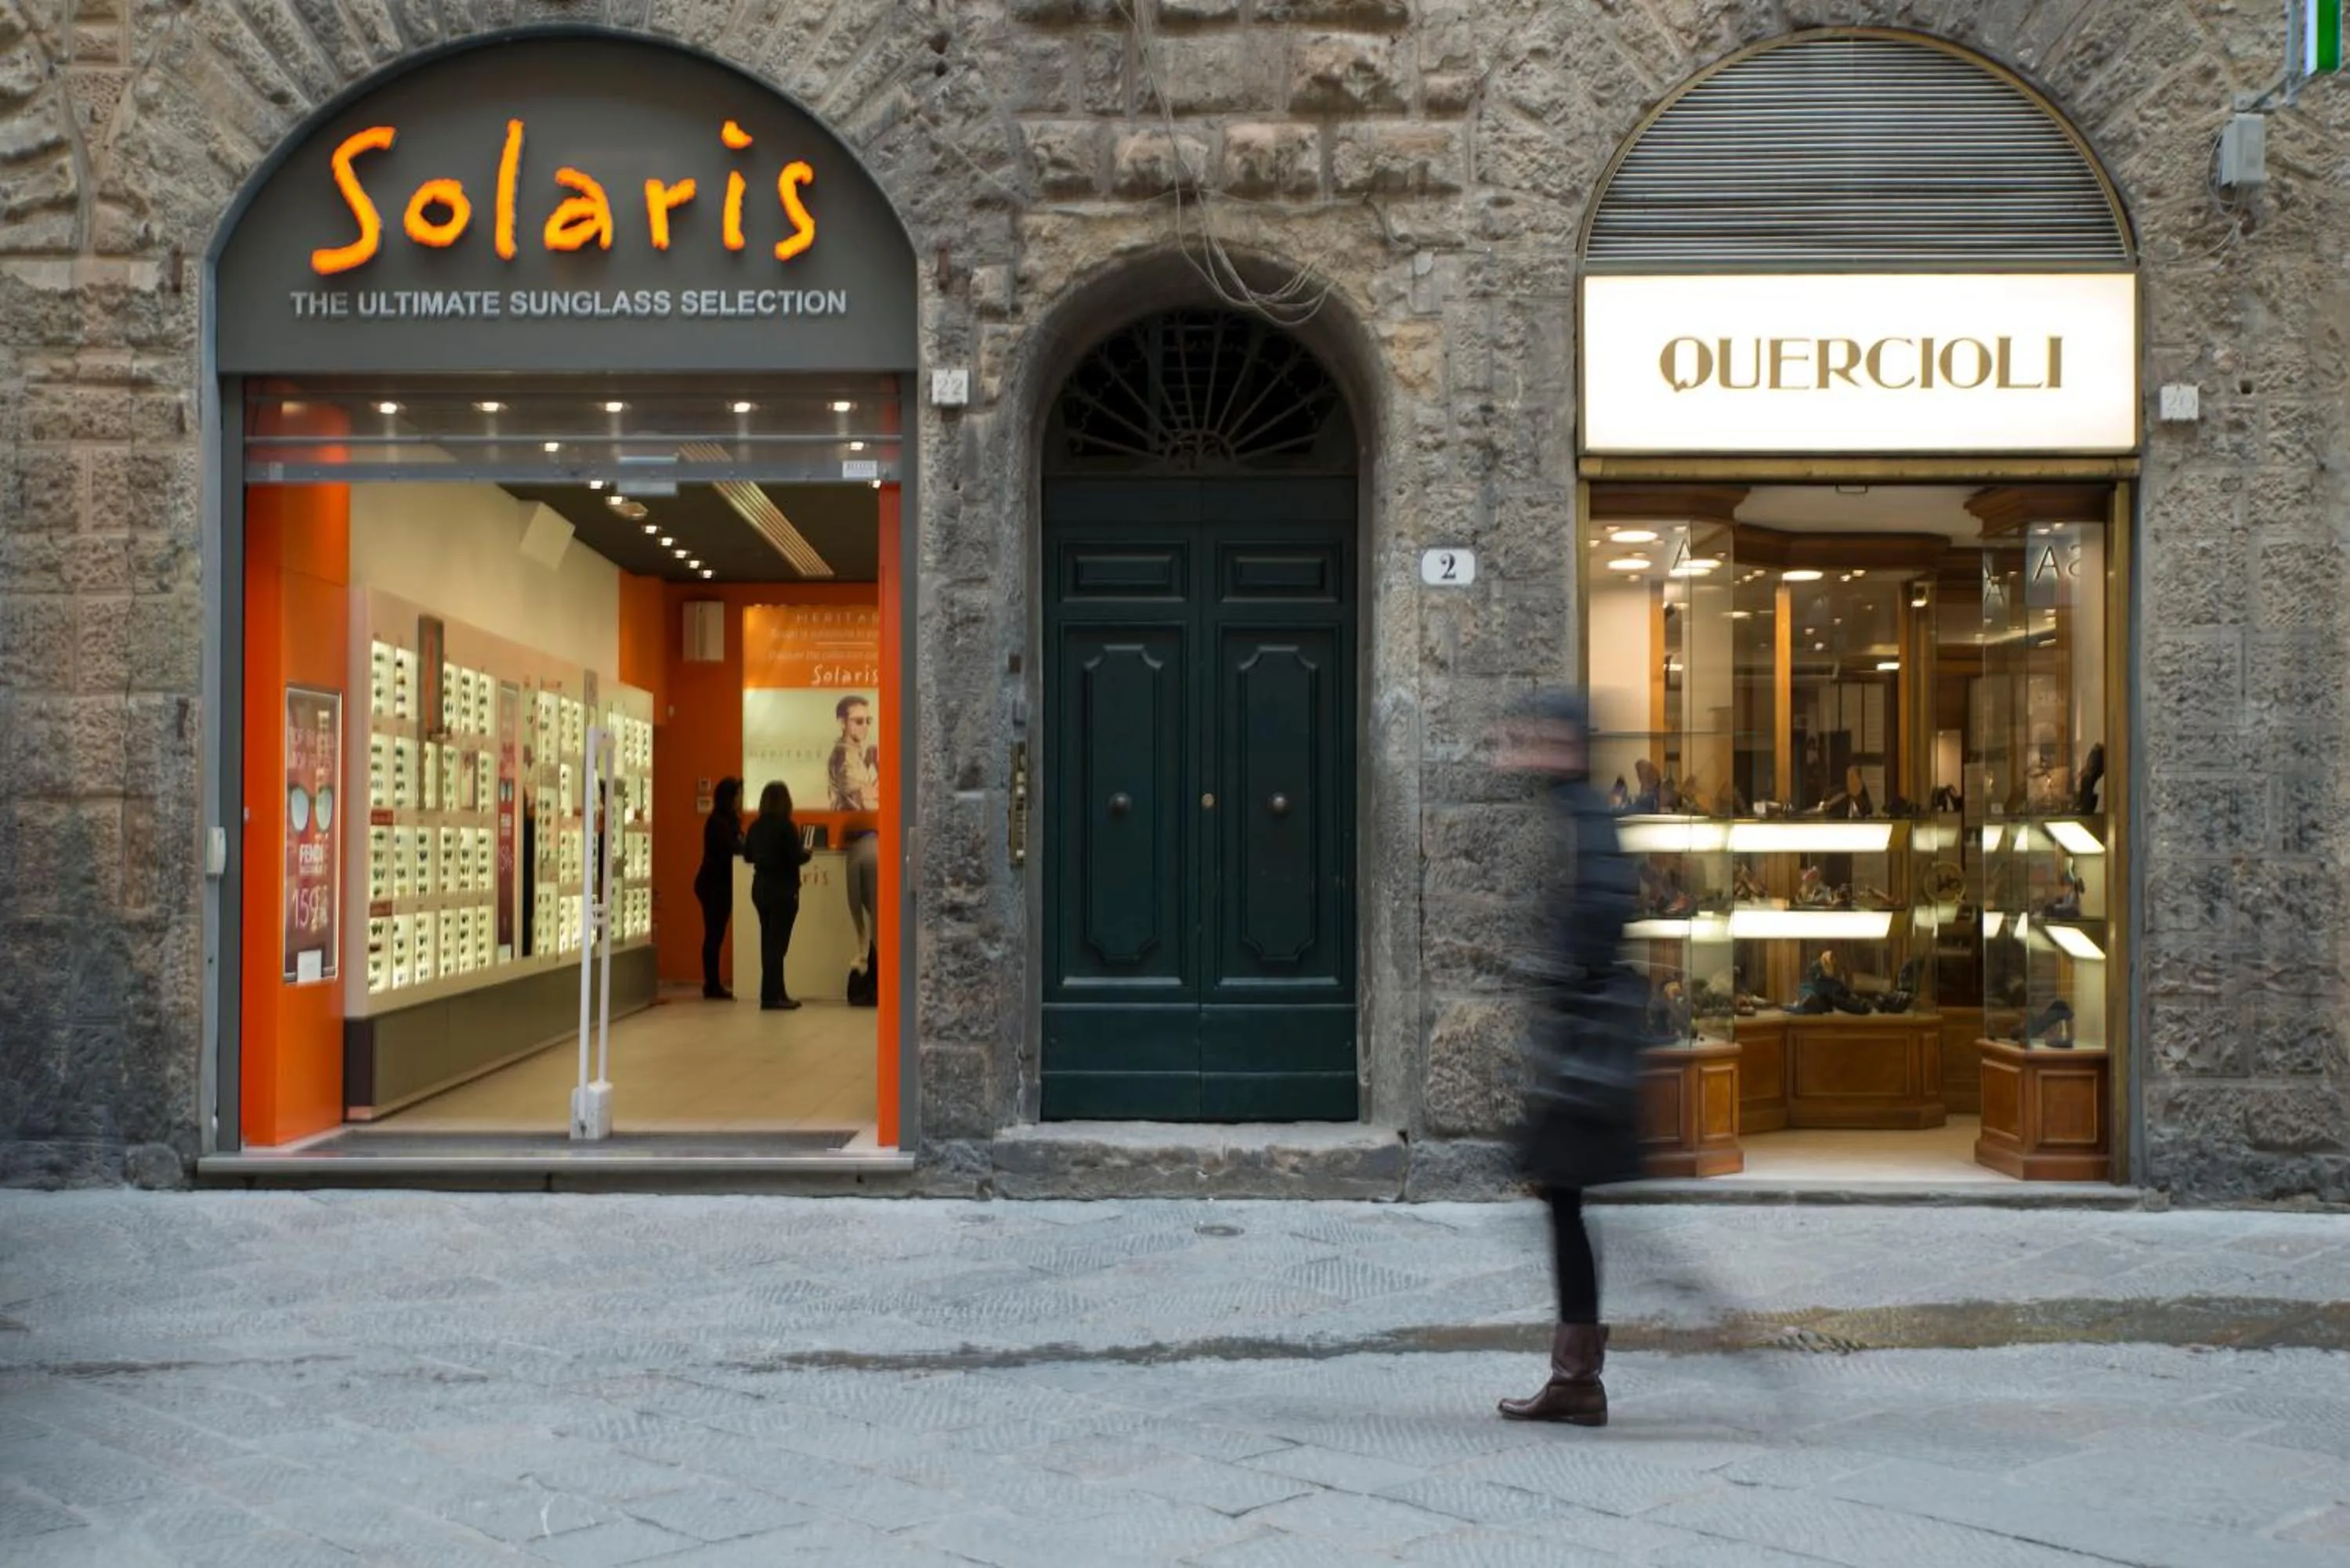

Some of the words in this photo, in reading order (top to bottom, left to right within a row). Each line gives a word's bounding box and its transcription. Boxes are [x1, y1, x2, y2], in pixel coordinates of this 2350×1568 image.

[312, 119, 815, 274] Solaris
[289, 291, 349, 317] THE
[358, 290, 501, 317] ULTIMATE
[509, 290, 671, 316] SUNGLASS
[681, 288, 847, 316] SELECTION
[1658, 334, 2063, 392] QUERCIOLI
[1440, 553, 1456, 579] 2
[812, 663, 879, 686] Solaris
